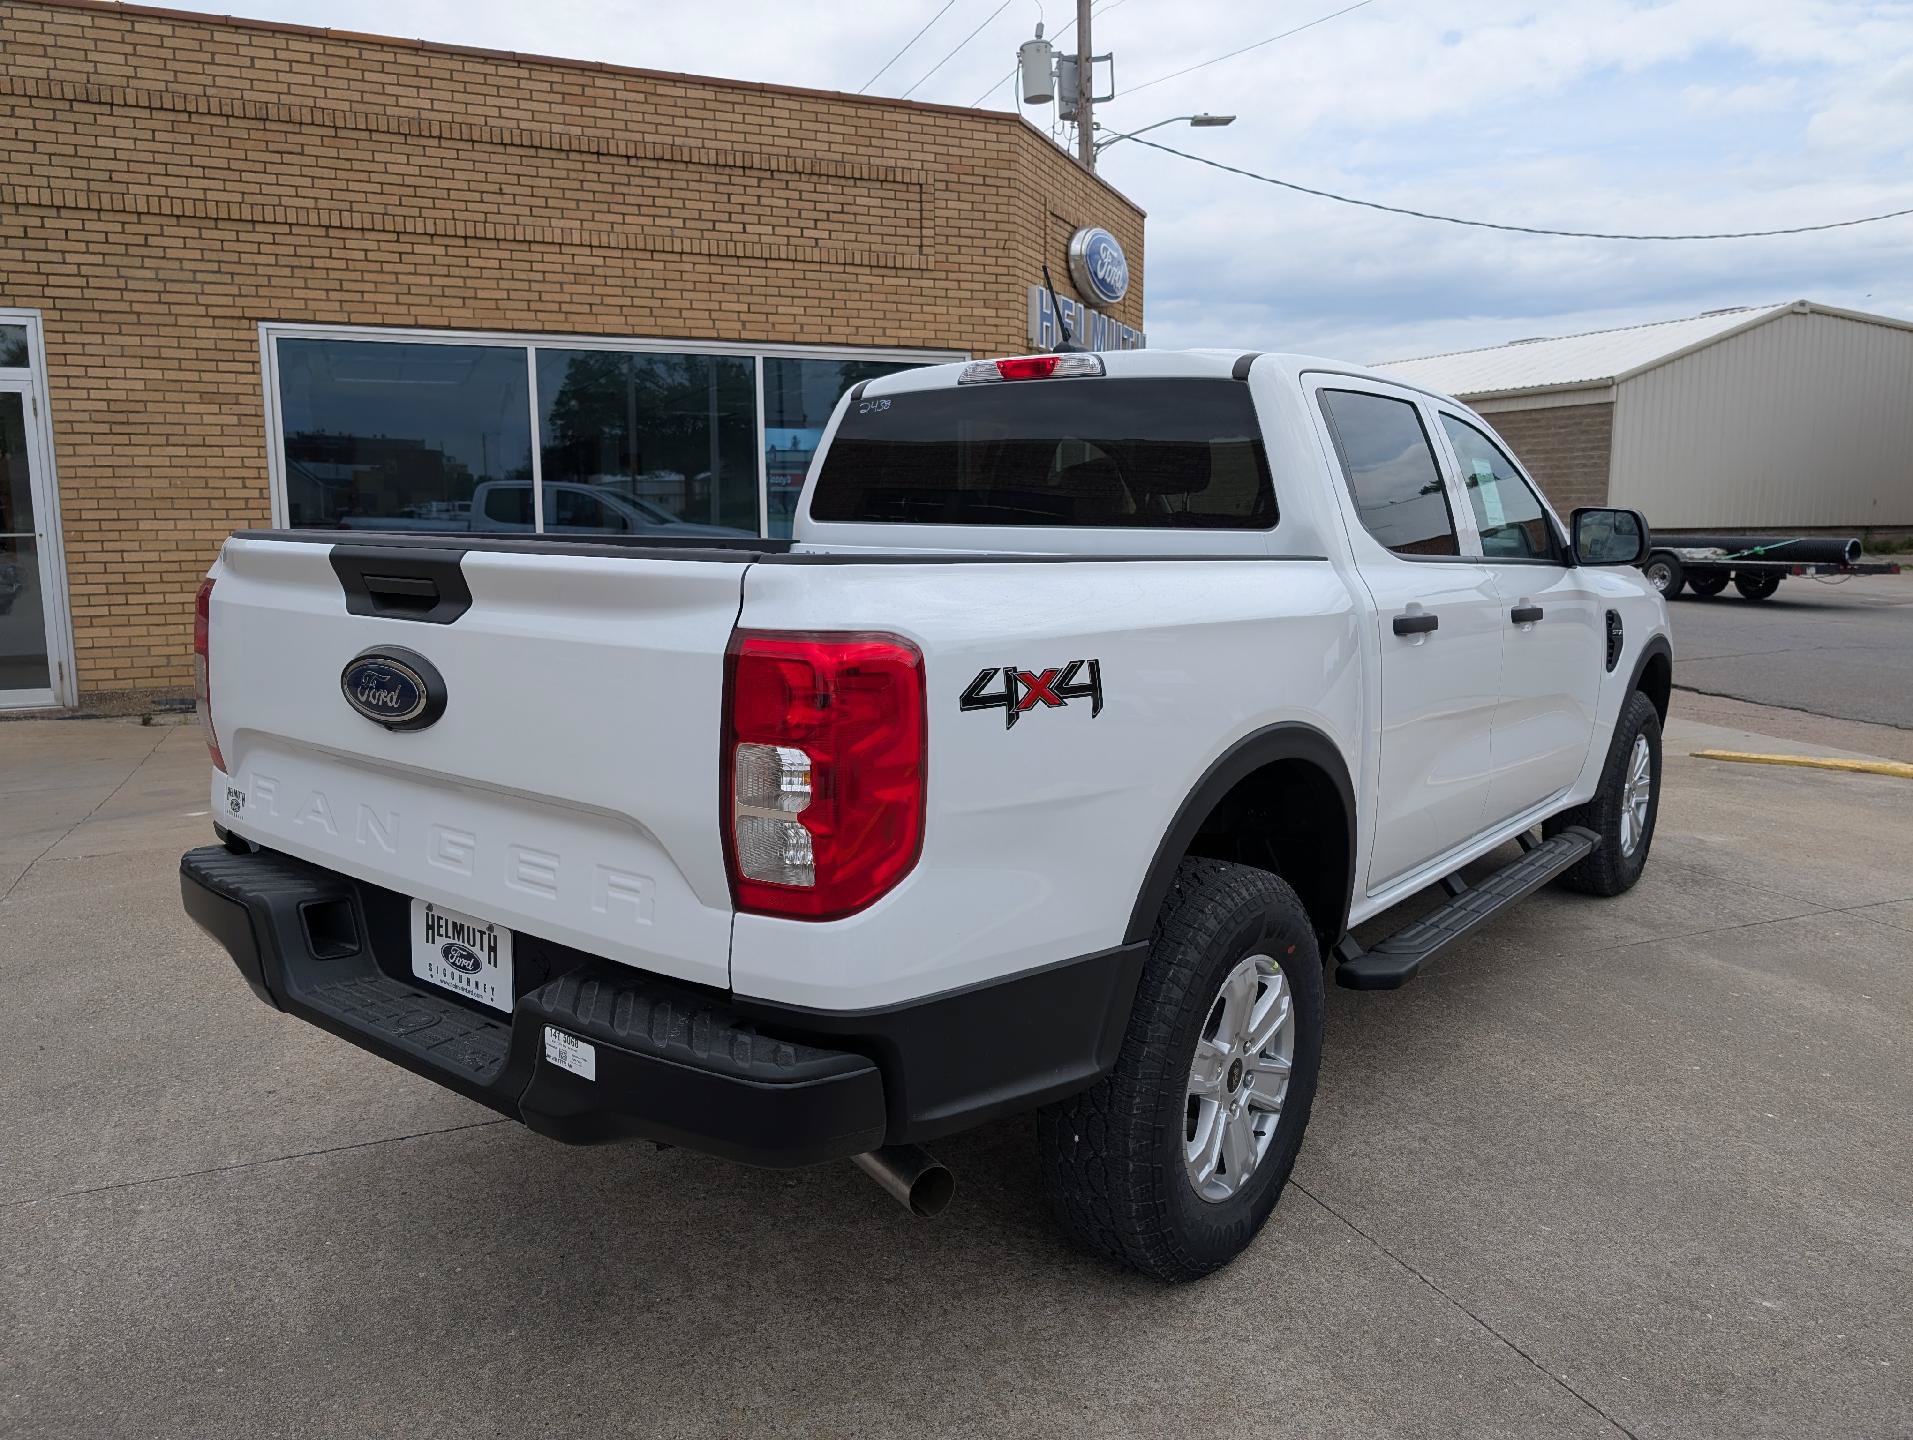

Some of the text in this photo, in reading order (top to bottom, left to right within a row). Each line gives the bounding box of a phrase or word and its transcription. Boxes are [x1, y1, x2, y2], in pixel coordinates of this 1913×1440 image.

[1096, 243, 1124, 291] Ford
[859, 399, 892, 414] 2438
[355, 670, 402, 708] Ford
[246, 772, 658, 927] RANGER
[425, 912, 498, 968] HELMUTH
[447, 946, 476, 971] Ford
[428, 962, 495, 993] SIGOURNEY
